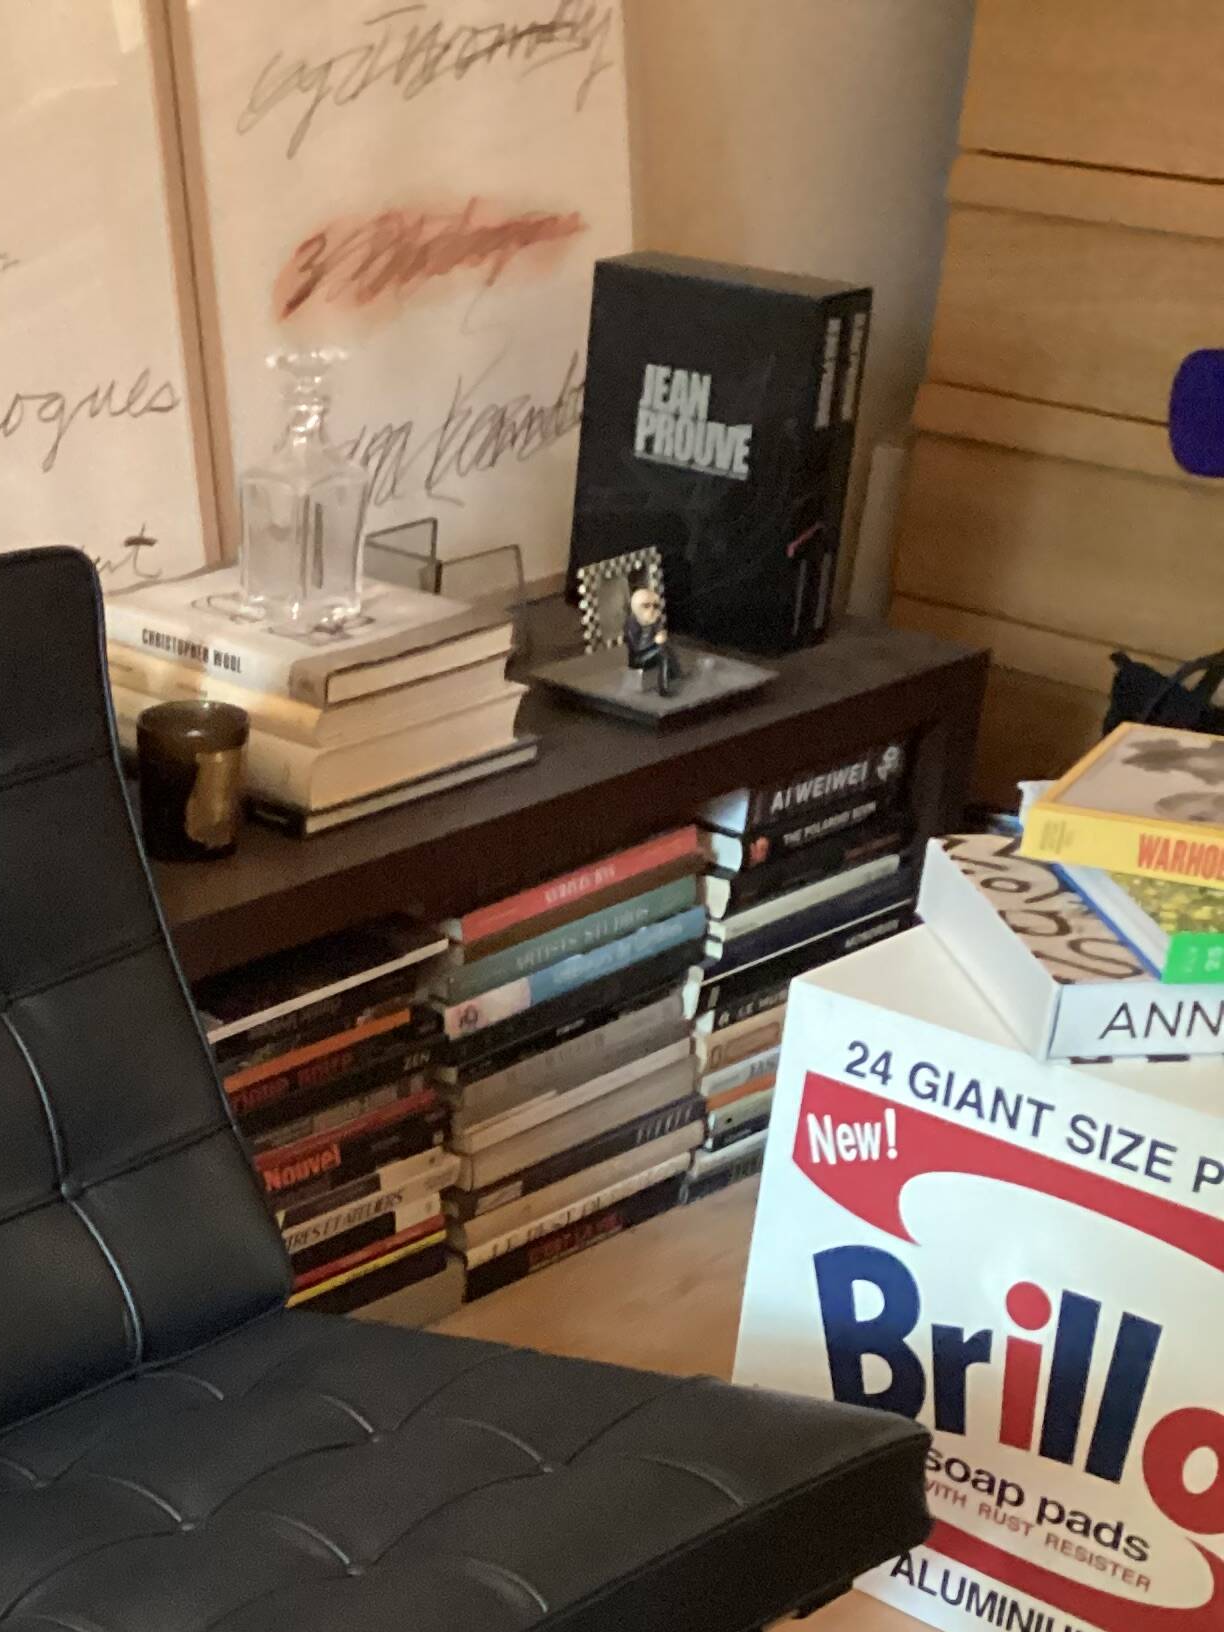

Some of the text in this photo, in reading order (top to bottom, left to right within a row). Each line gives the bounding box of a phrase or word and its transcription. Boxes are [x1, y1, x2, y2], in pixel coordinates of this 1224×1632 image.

[641, 363, 712, 421] JEAN
[634, 408, 753, 476] PROUVE
[141, 627, 241, 674] CHRISTOPHER WOOL
[771, 760, 869, 815] AI WEIWEI
[806, 1108, 899, 1166] New!
[844, 1040, 895, 1086] 24
[908, 1061, 1054, 1138] GIANT
[1065, 1113, 1178, 1182] SIZE
[812, 1244, 1224, 1536] Brillo
[926, 1446, 1151, 1563] soap pads
[978, 1502, 1036, 1538] RUST
[1044, 1532, 1152, 1593] RESISTER
